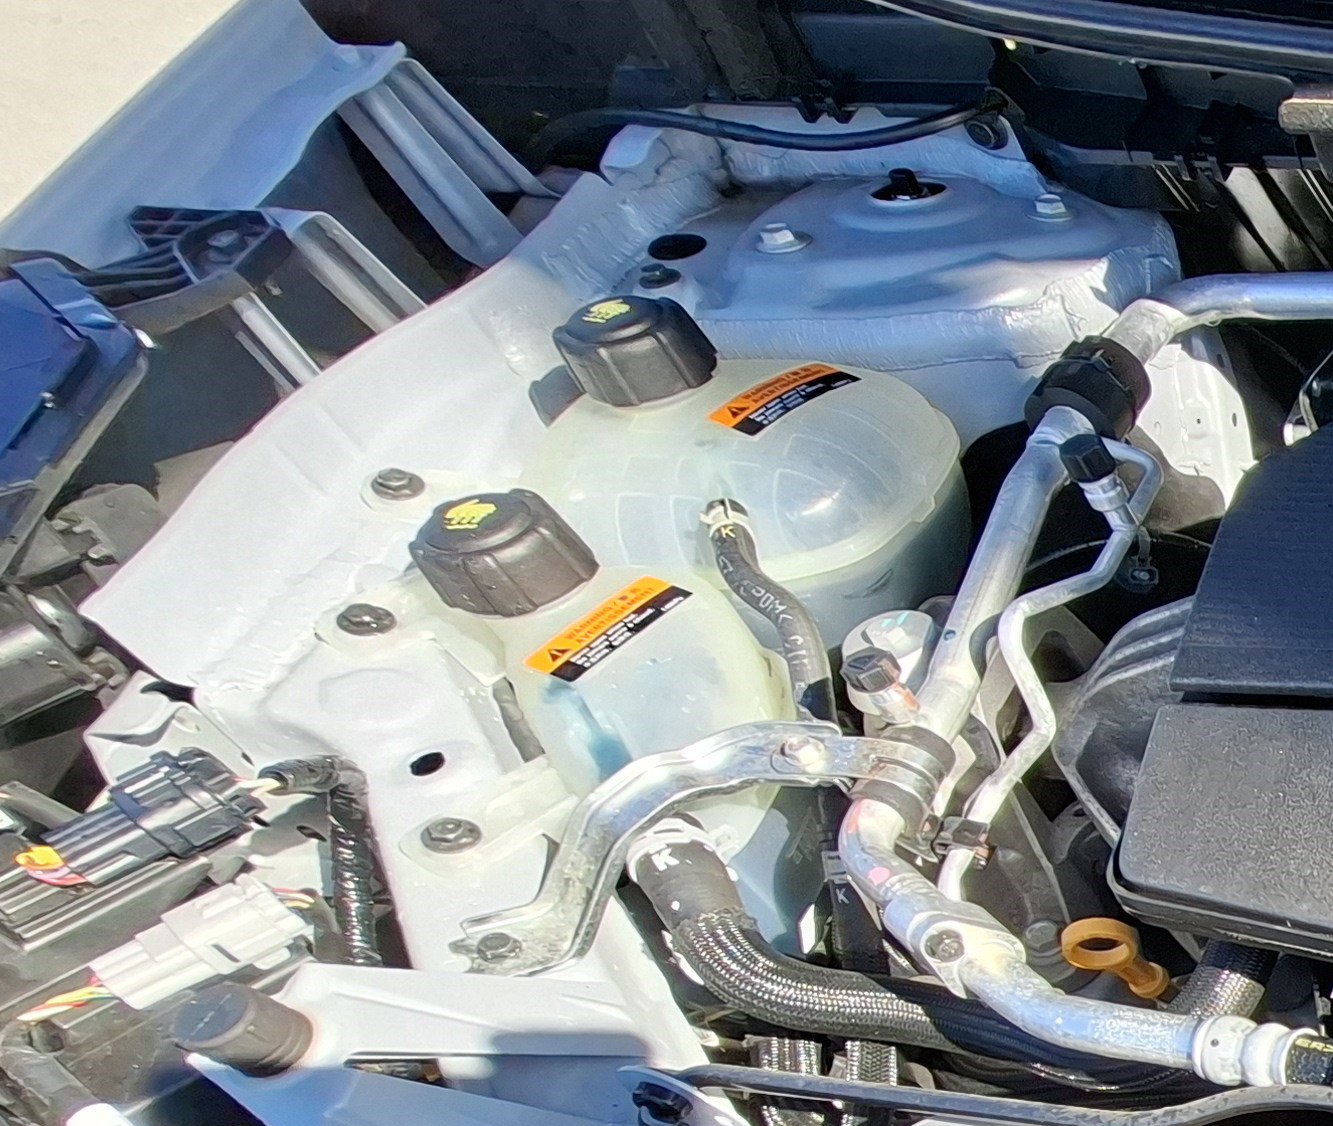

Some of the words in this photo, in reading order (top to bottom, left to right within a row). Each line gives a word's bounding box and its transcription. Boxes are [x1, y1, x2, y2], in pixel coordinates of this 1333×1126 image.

[720, 526, 736, 539] K
[651, 848, 680, 872] K
[835, 887, 850, 904] K
